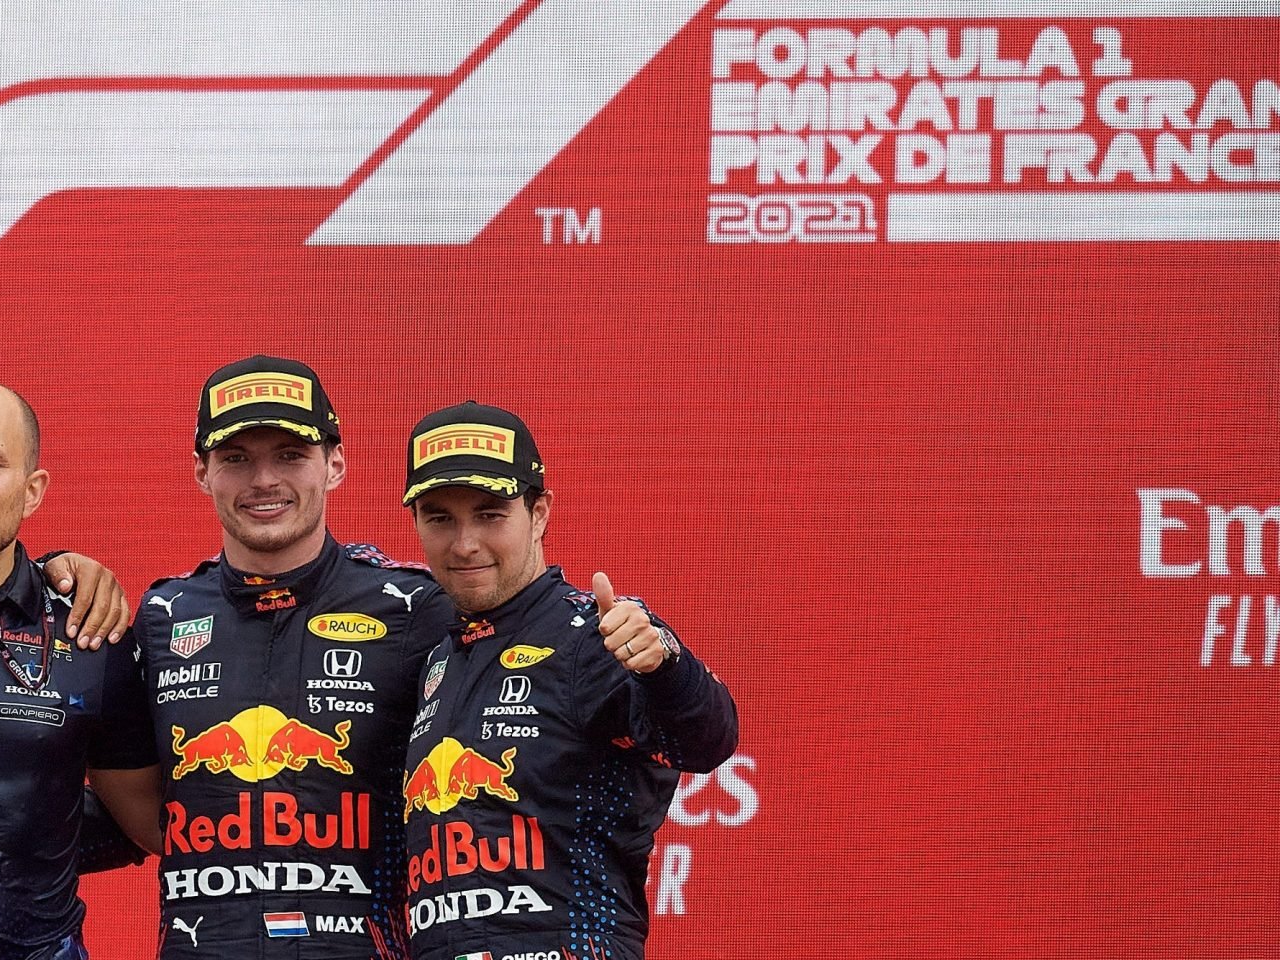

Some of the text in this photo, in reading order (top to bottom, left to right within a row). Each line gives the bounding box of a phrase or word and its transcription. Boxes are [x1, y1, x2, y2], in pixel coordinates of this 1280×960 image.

[711, 26, 1133, 78] FORMULA 1
[710, 79, 1085, 130] EMIRATES
[710, 132, 884, 184] PRIX
[894, 132, 991, 183] DE
[536, 207, 603, 245] TM
[706, 193, 878, 243] 2021
[216, 378, 305, 409] PIRELLI
[420, 430, 506, 460] PIRELLI
[256, 596, 297, 613] Red Bull
[176, 621, 210, 636] TAG
[328, 620, 377, 635] RAUCH
[3, 631, 42, 645] Red Bull
[171, 633, 210, 655] HEUER
[157, 665, 201, 689] Mobil
[306, 679, 376, 692] HONDA
[5, 685, 62, 699] HONDA
[157, 685, 219, 704] ORACLE
[0, 707, 60, 721] GIANPIERO
[325, 696, 375, 714] Tezos
[482, 706, 539, 716] HONDA
[496, 722, 540, 738] Tezos
[165, 791, 370, 856] Red Bull
[407, 814, 545, 894] ed Bull
[164, 861, 372, 900] HONDA
[315, 915, 366, 934] MAX
